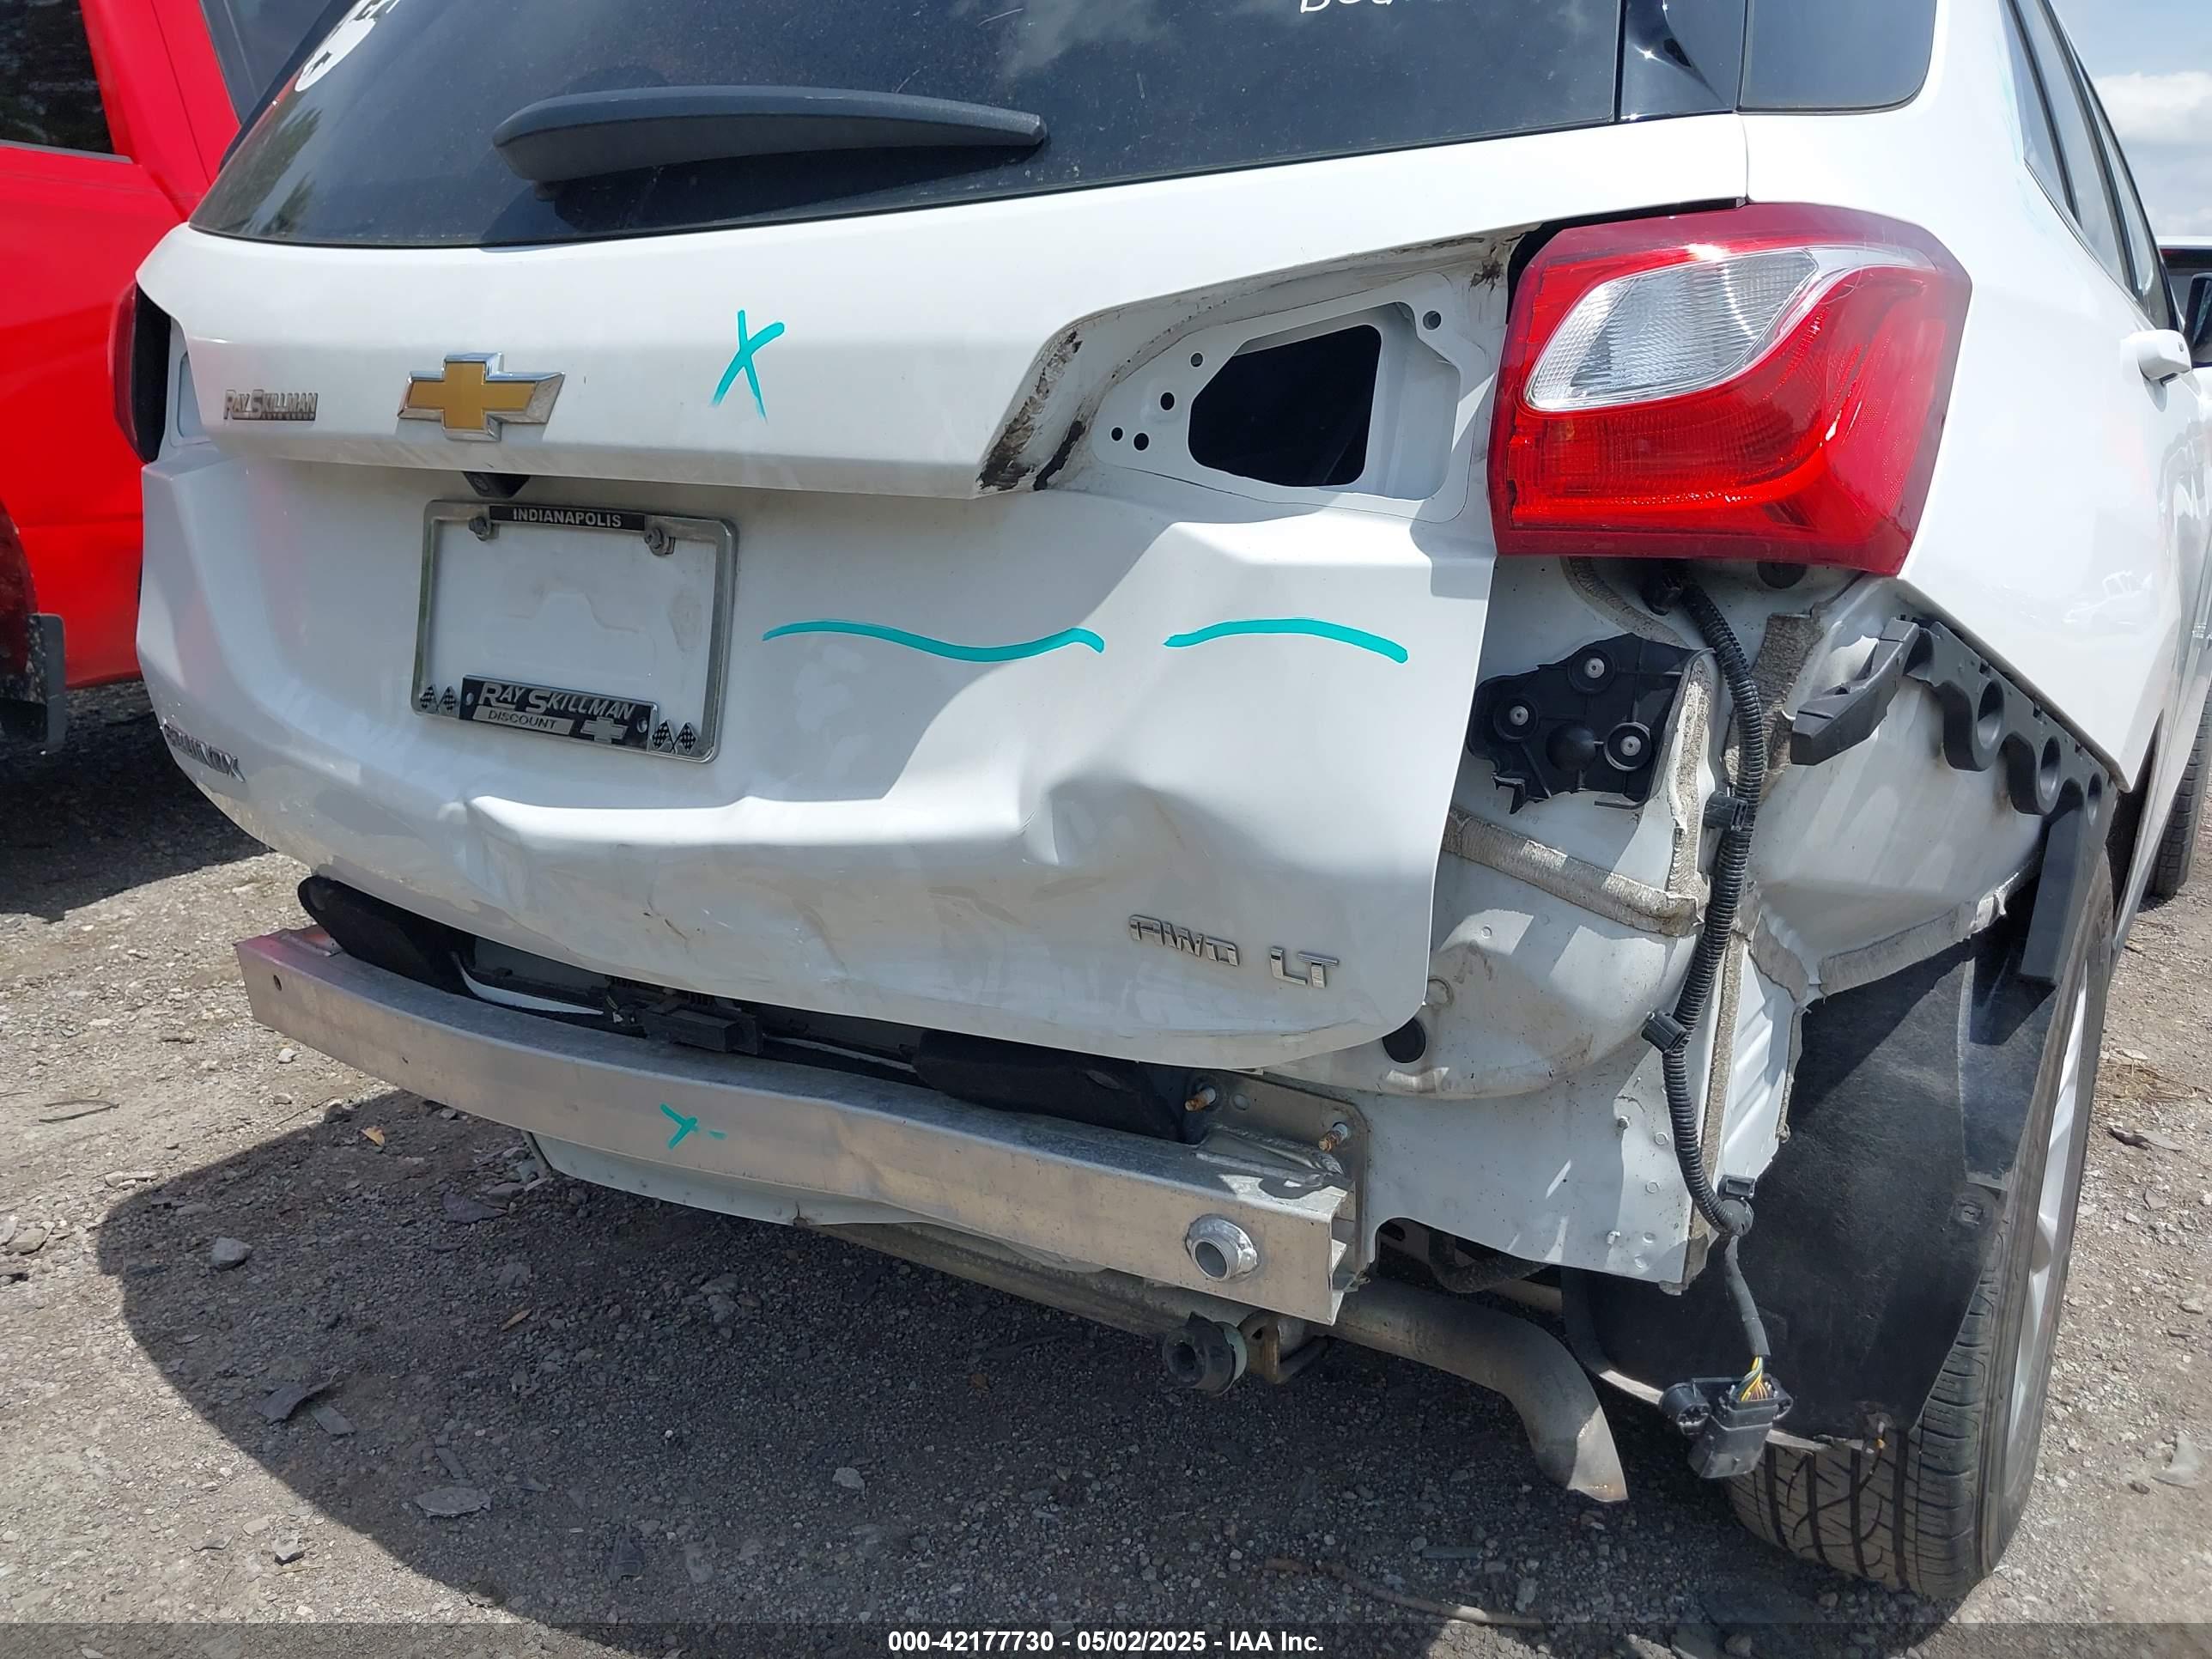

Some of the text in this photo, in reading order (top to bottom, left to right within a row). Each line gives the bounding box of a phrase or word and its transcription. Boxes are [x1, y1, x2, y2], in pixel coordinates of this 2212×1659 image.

[223, 389, 319, 419] RAY SKILLMAN
[513, 507, 623, 528] INDIANAPOLIS
[478, 683, 637, 720] RAY SKILLMAN
[488, 709, 557, 731] DISCOUNT
[1270, 945, 1340, 988] LT
